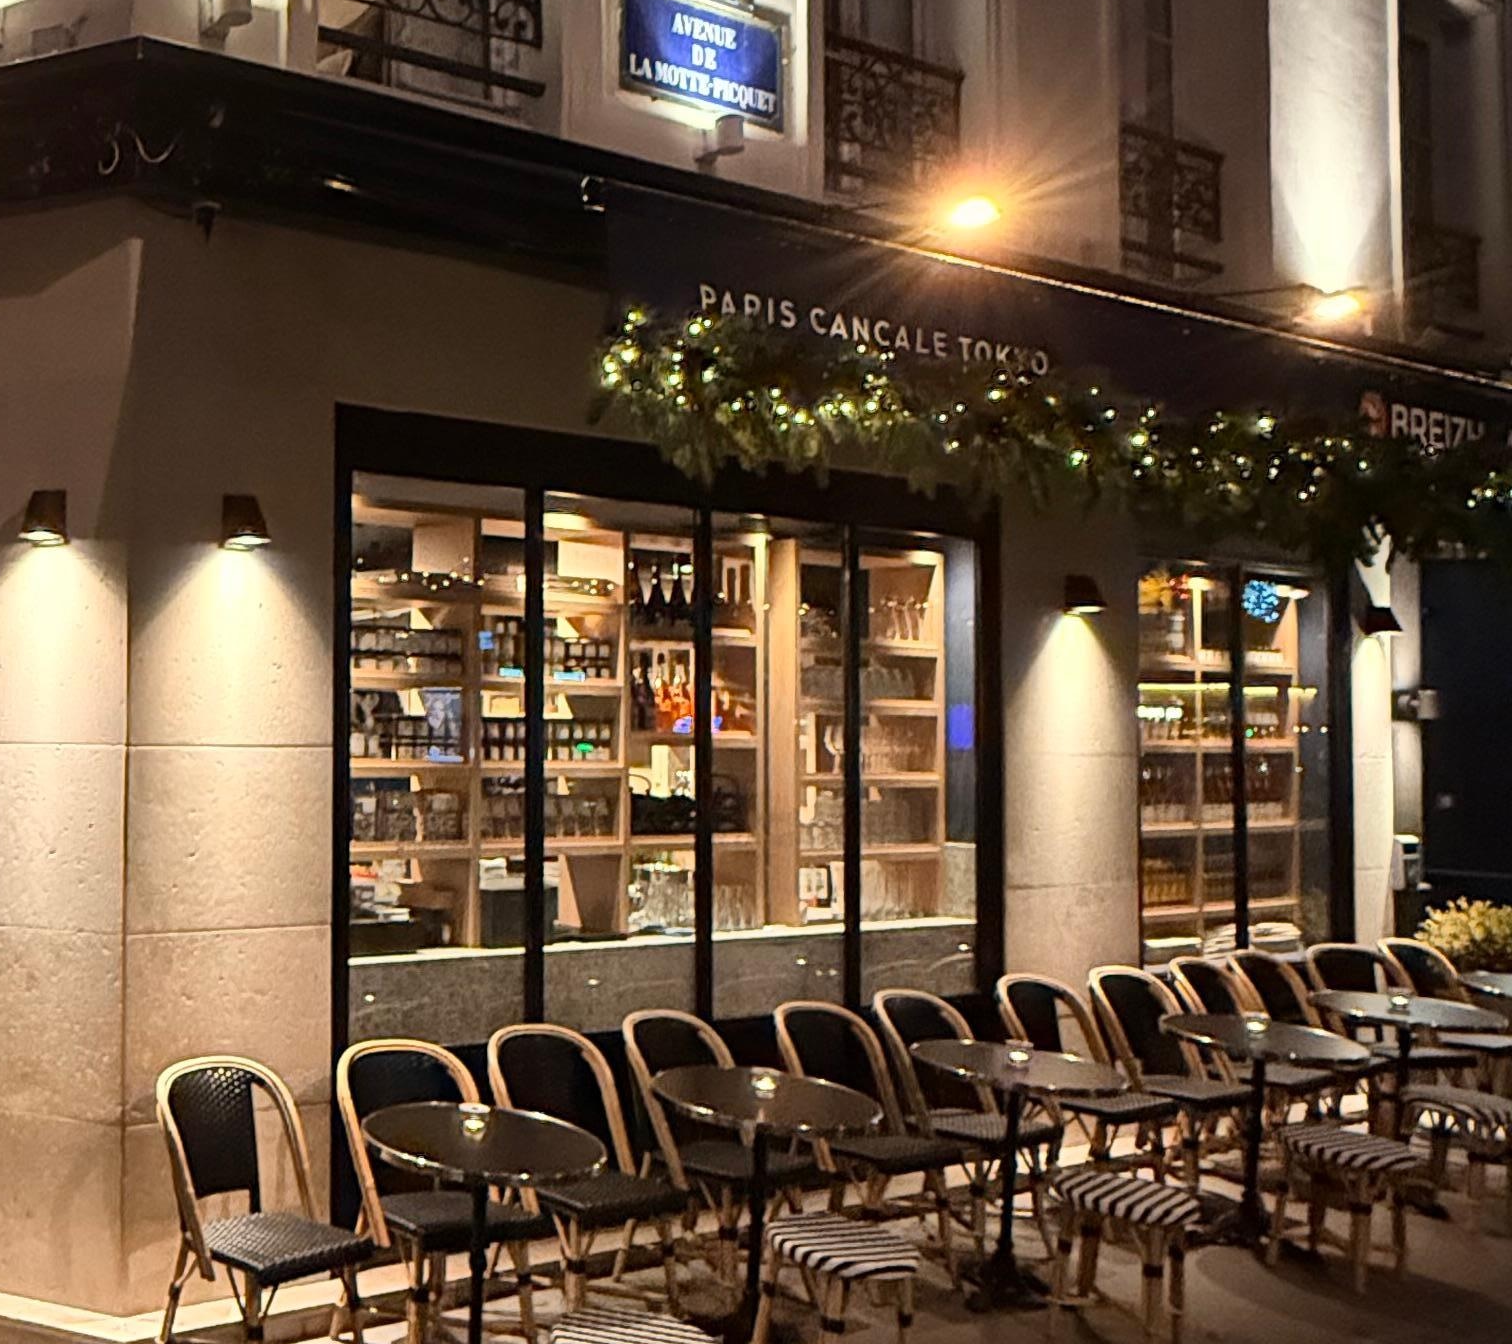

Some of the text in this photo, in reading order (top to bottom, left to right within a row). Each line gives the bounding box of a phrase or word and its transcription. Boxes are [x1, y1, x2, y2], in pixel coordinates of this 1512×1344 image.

[672, 12, 737, 49] AVENUE
[691, 44, 717, 70] DE
[629, 54, 777, 112] LA MOTTE-PICQUET
[699, 284, 796, 329] PARIS
[809, 307, 948, 357] CANCALE
